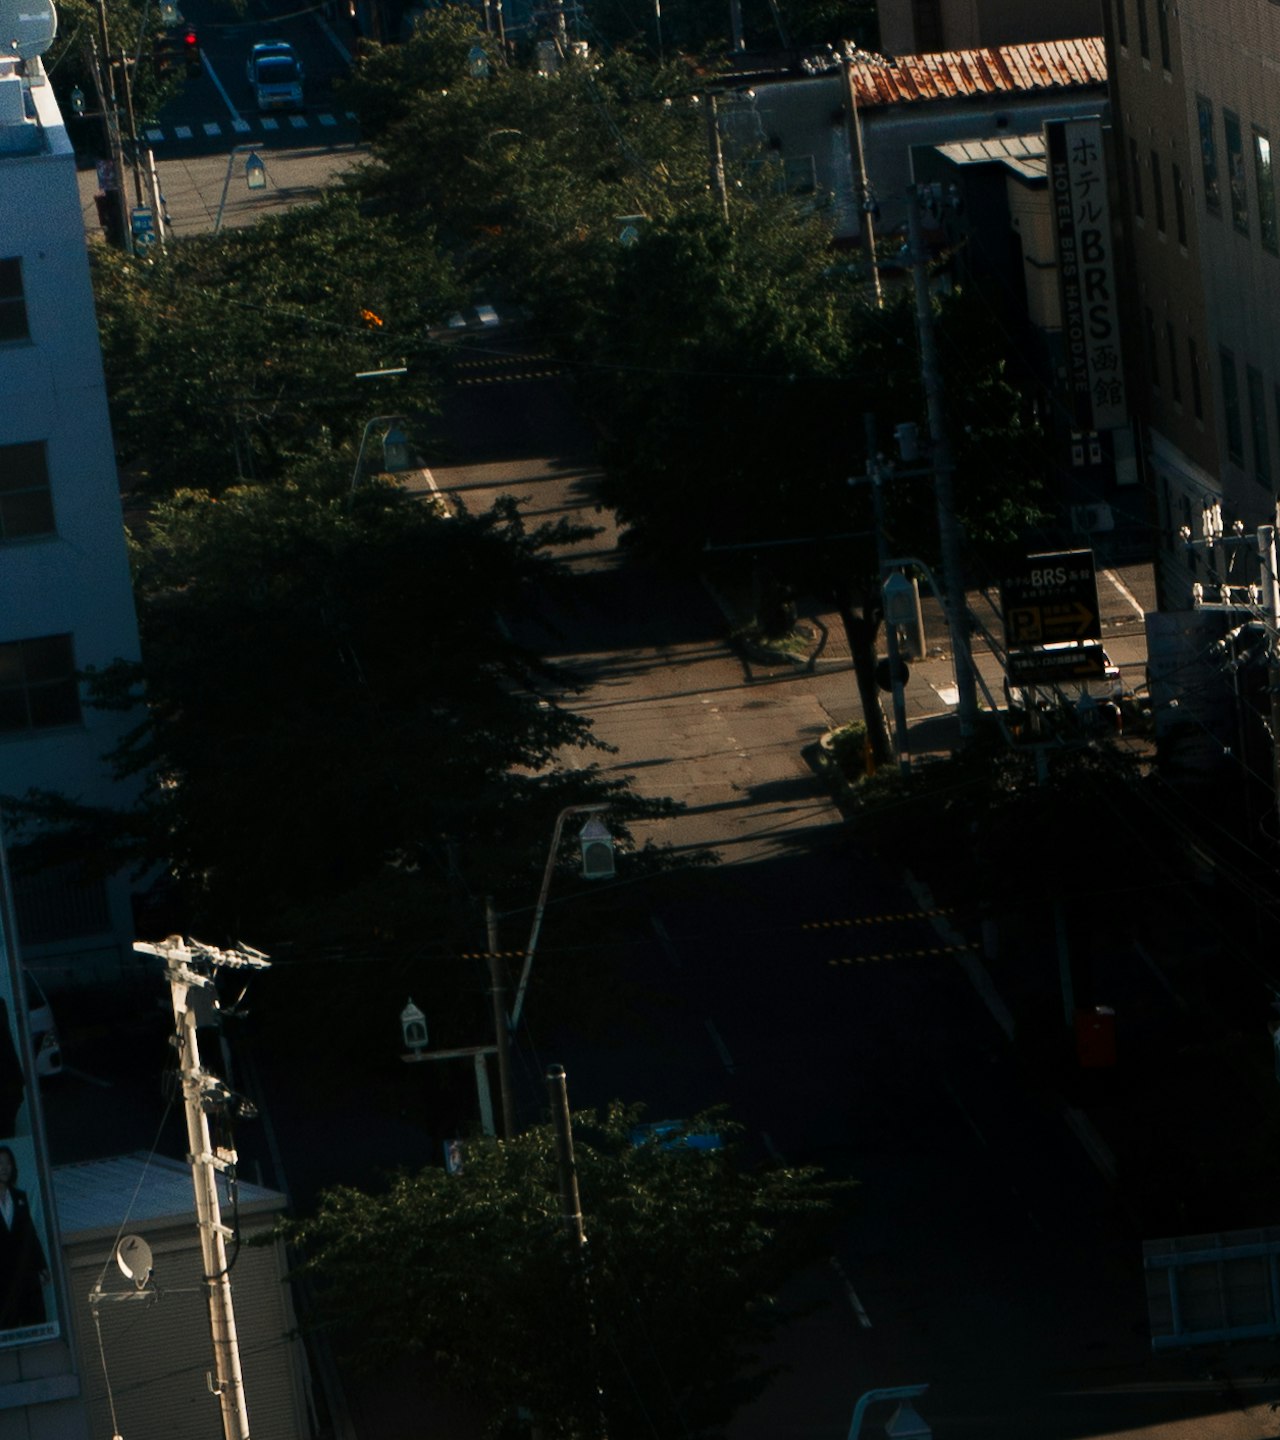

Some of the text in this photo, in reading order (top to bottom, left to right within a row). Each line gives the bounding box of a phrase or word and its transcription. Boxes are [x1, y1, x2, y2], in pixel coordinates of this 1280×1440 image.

[1053, 163, 1089, 393] HOTEL BRS HAKODATE
[1072, 137, 1122, 407] ホテルBRS函館
